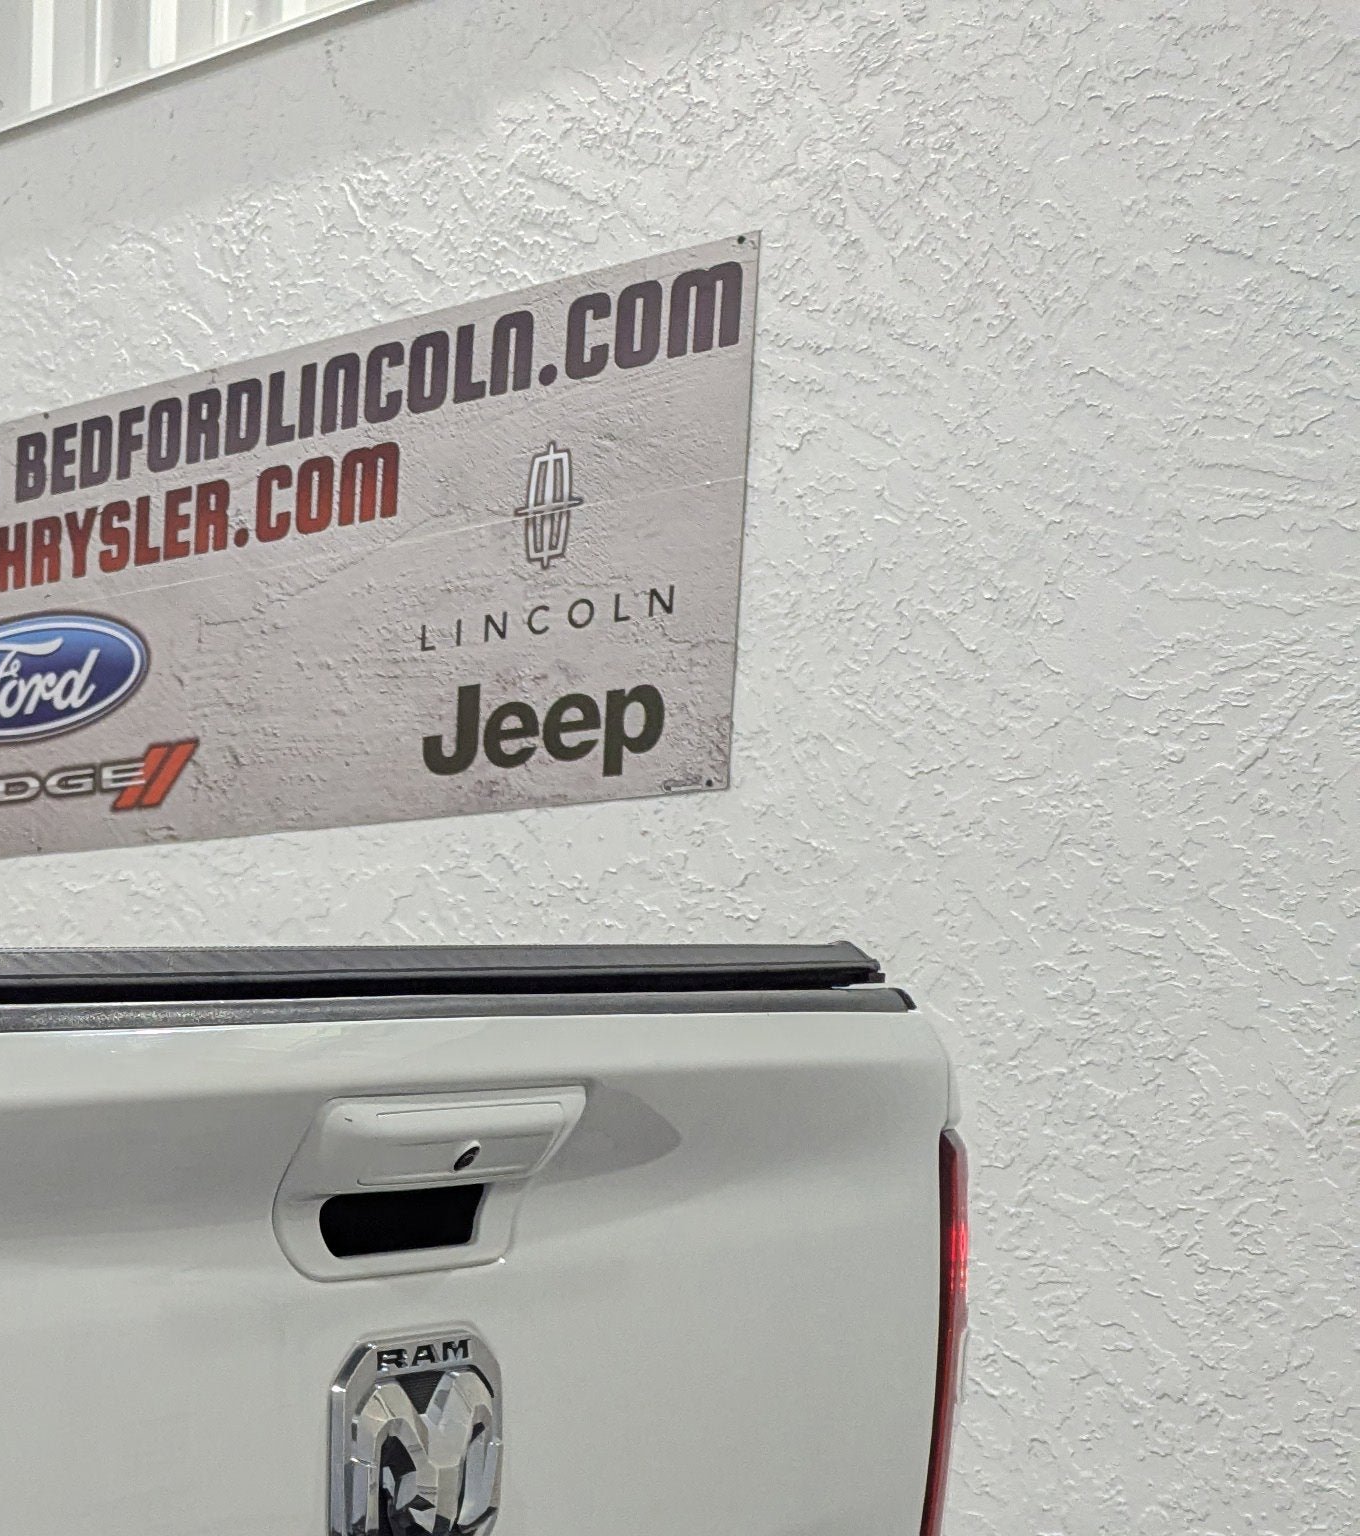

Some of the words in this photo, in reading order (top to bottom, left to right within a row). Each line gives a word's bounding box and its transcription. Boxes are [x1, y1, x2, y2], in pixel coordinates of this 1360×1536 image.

[15, 260, 744, 503] BEDFORDLINCOLN.COM
[421, 585, 675, 651] LINCOLN
[422, 683, 665, 777] Jeep
[376, 1338, 472, 1371] RAM
